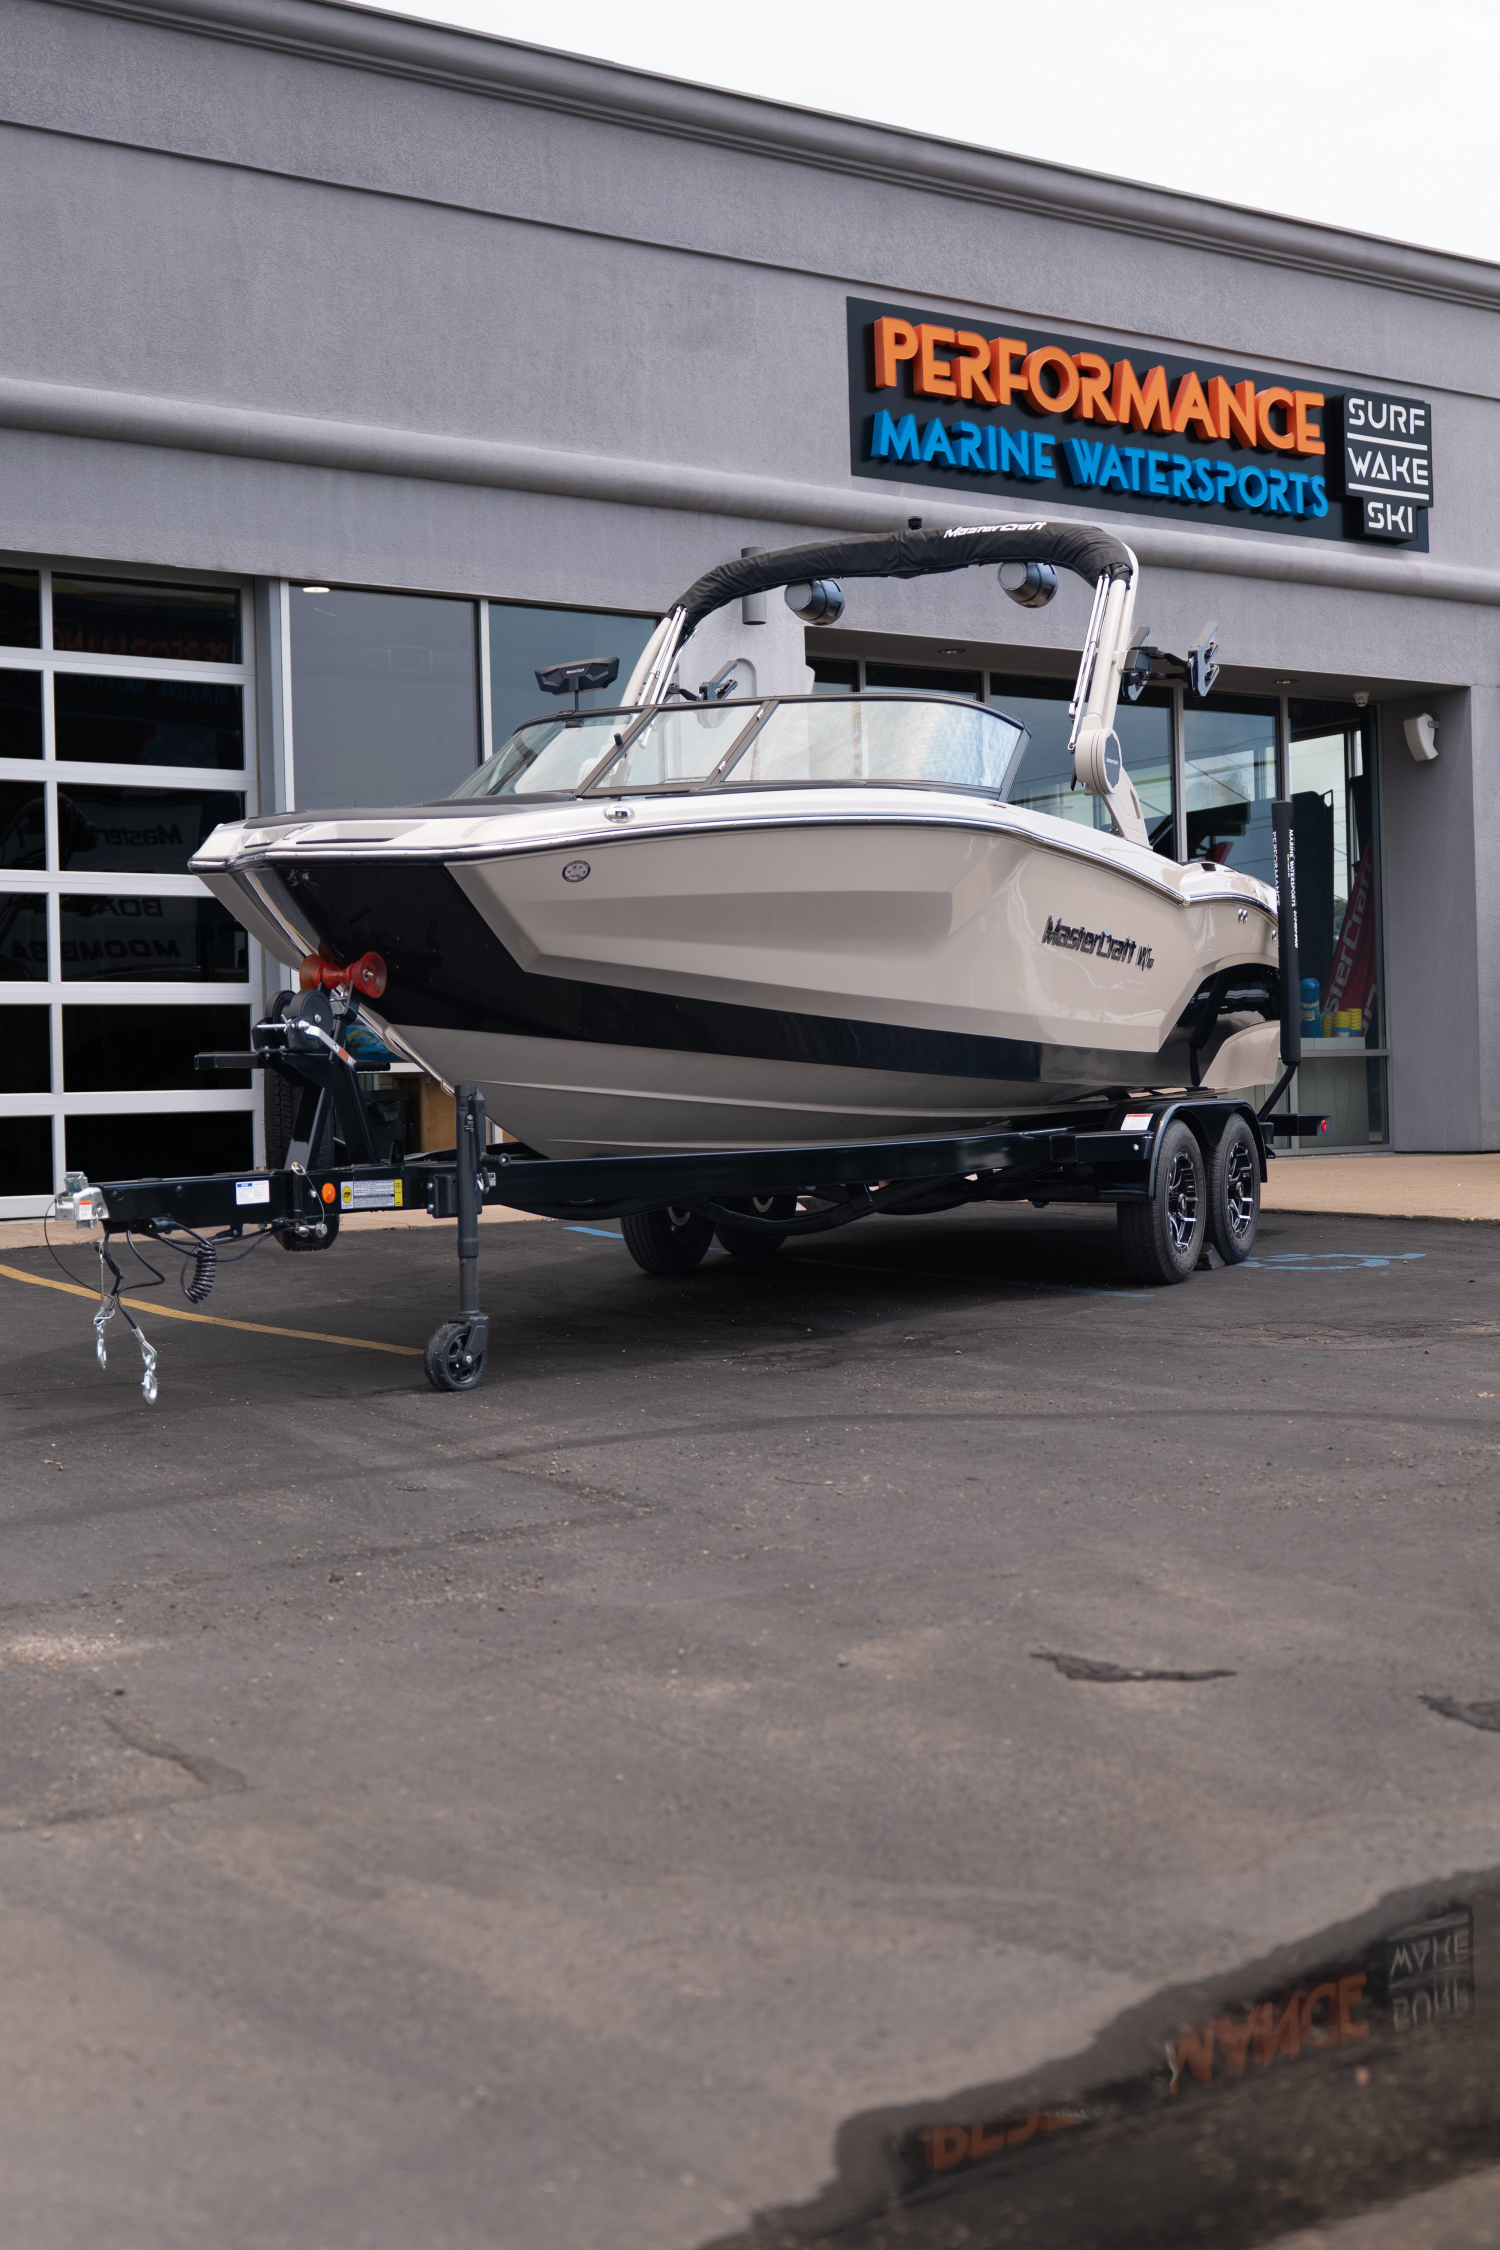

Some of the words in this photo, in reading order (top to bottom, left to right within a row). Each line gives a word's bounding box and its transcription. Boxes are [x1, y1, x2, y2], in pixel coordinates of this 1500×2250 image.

[873, 316, 1326, 456] PERFORMANCE
[1348, 397, 1427, 435] SURF
[870, 409, 1057, 481] MARINE
[1063, 436, 1329, 519] WATERSPORTS
[1347, 446, 1430, 486] WAKE
[943, 521, 1047, 539] MasterCraft
[1367, 502, 1414, 534] SKI
[1041, 915, 1136, 963] MasterCraft
[1323, 855, 1373, 1013] sterCraft
